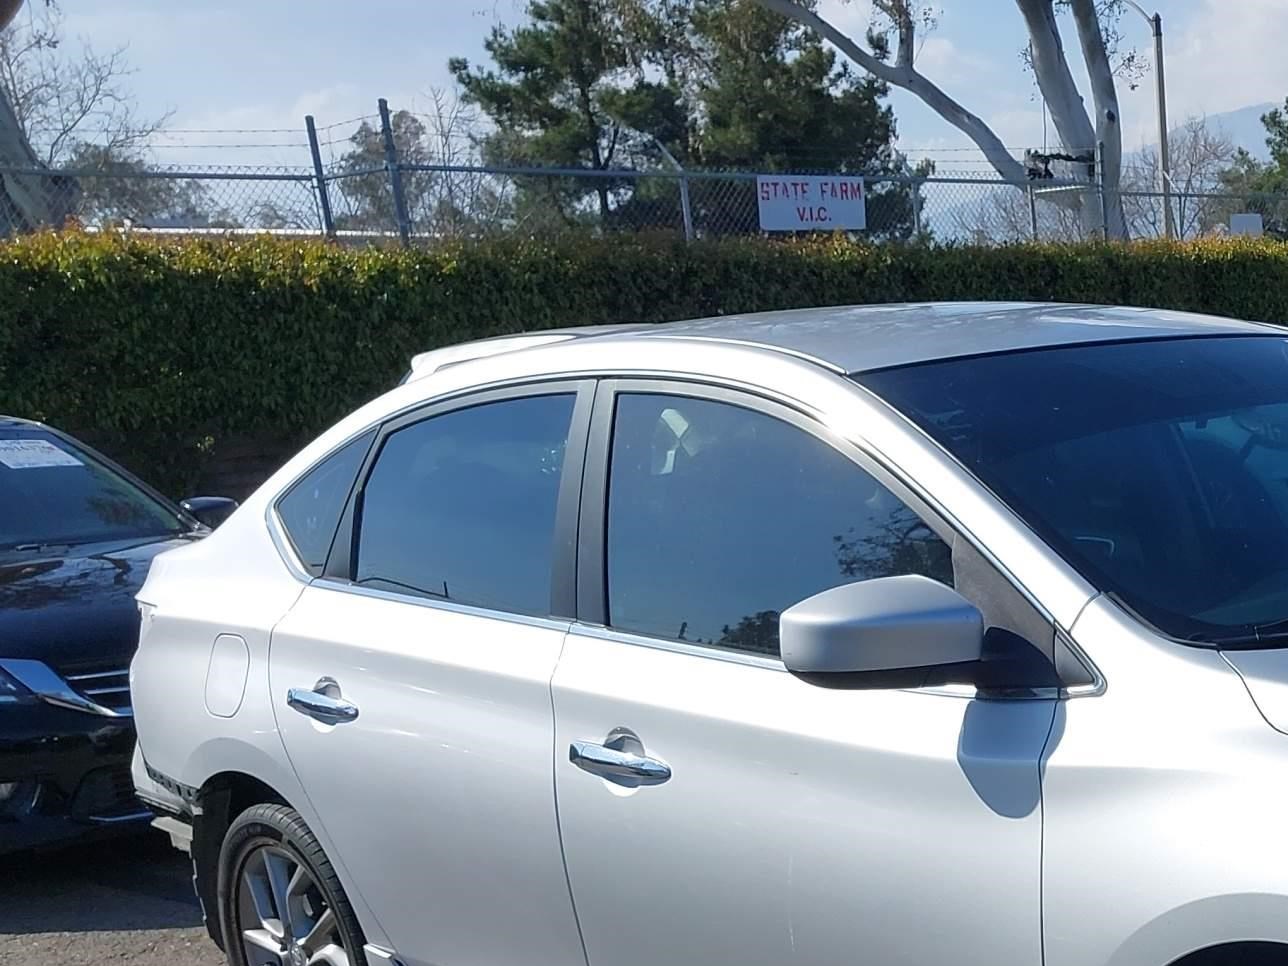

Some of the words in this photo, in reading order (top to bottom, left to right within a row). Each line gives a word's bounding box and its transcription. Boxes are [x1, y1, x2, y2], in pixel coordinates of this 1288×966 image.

[760, 182, 809, 201] STATE
[820, 182, 862, 201] FARM
[797, 206, 832, 222] V.I.C.
